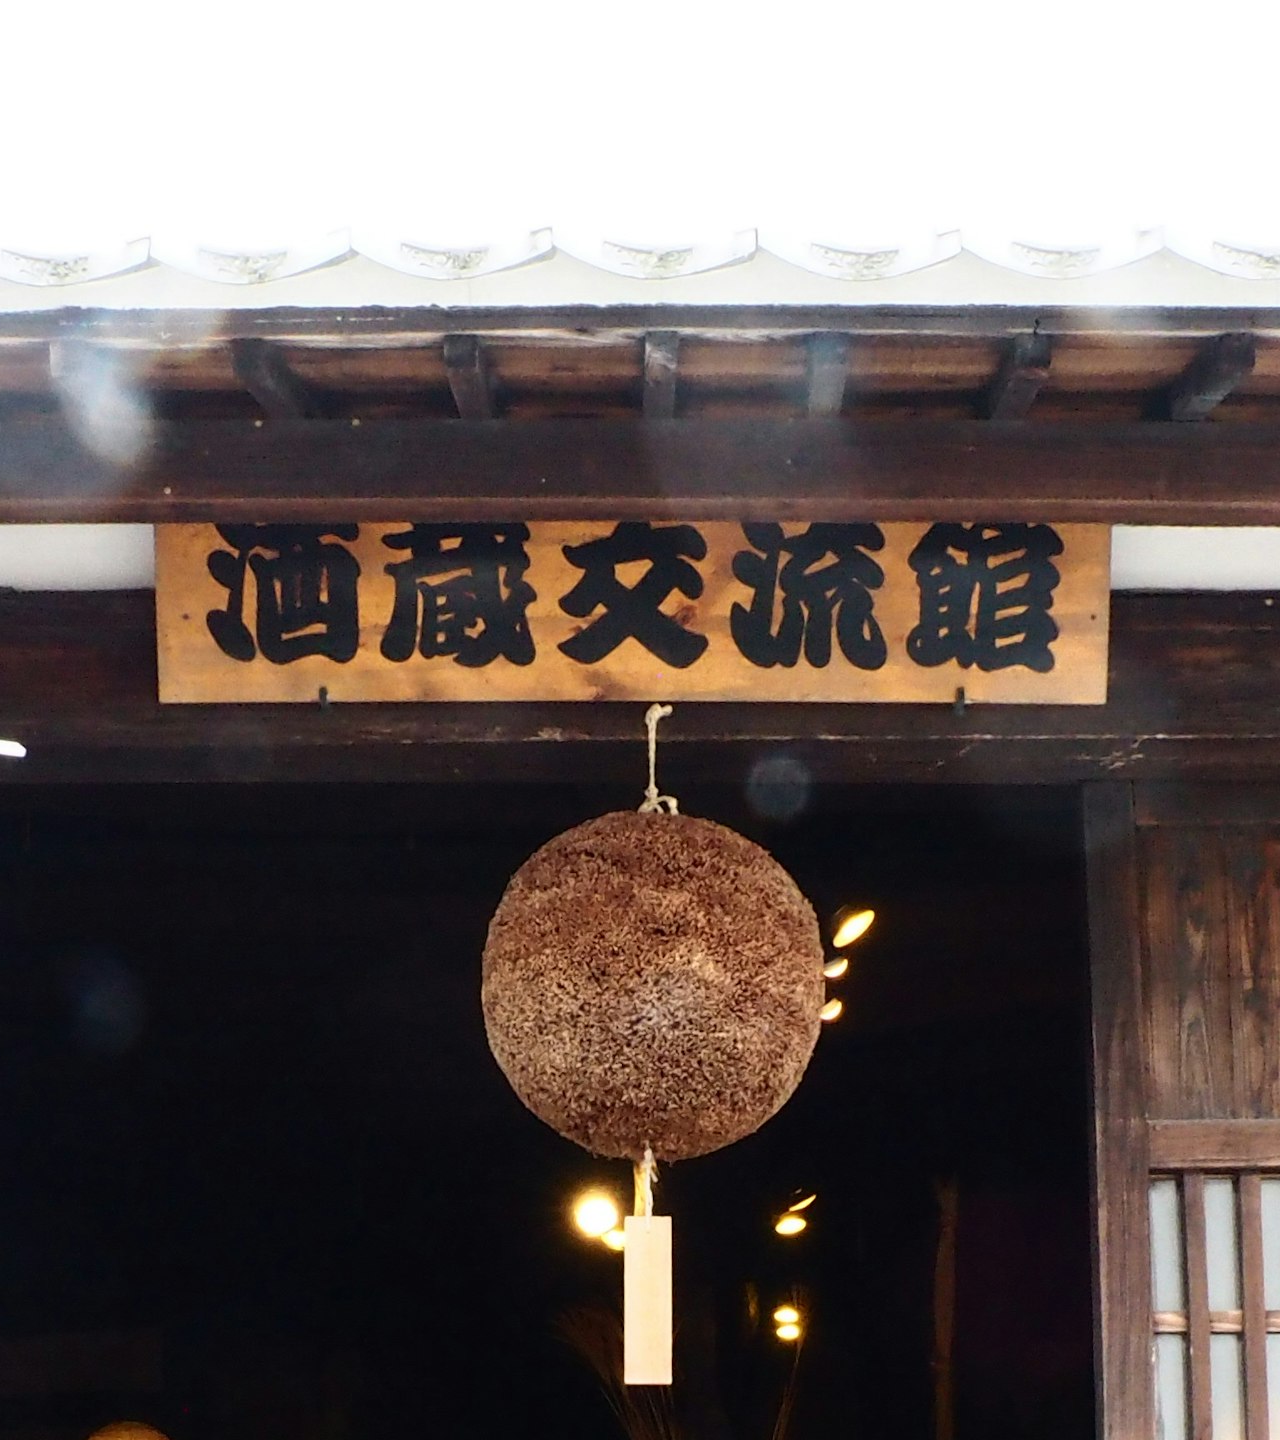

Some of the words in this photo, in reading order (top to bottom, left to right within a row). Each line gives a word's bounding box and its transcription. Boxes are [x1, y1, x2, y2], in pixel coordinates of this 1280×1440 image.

[206, 522, 1065, 672] 酒蔵交流館
